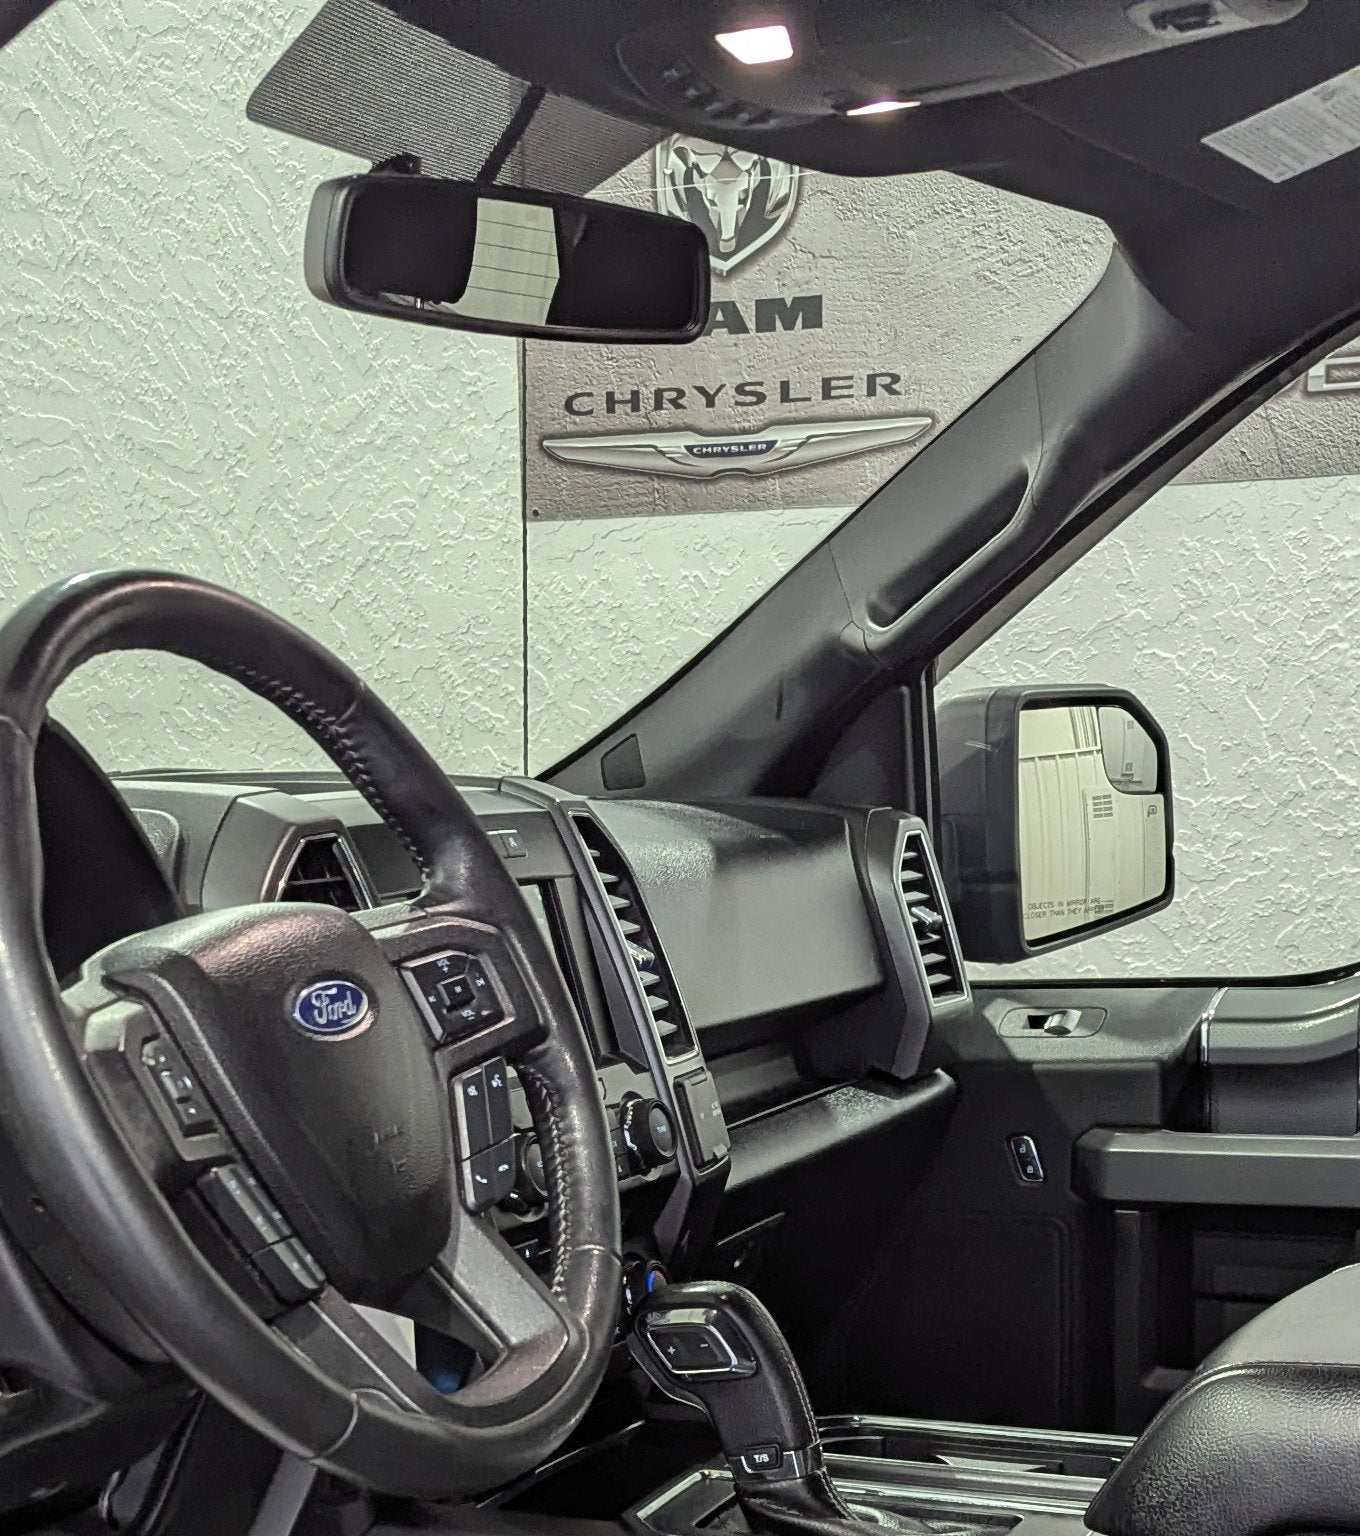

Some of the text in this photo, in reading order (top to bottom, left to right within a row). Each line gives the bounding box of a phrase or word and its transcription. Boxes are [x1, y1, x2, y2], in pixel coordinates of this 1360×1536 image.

[704, 295, 823, 336] AM
[564, 372, 903, 417] CHRYSLER
[692, 442, 768, 456] CHRYSLER
[1028, 901, 1055, 911] OBJECTS
[311, 987, 357, 1025] Ford
